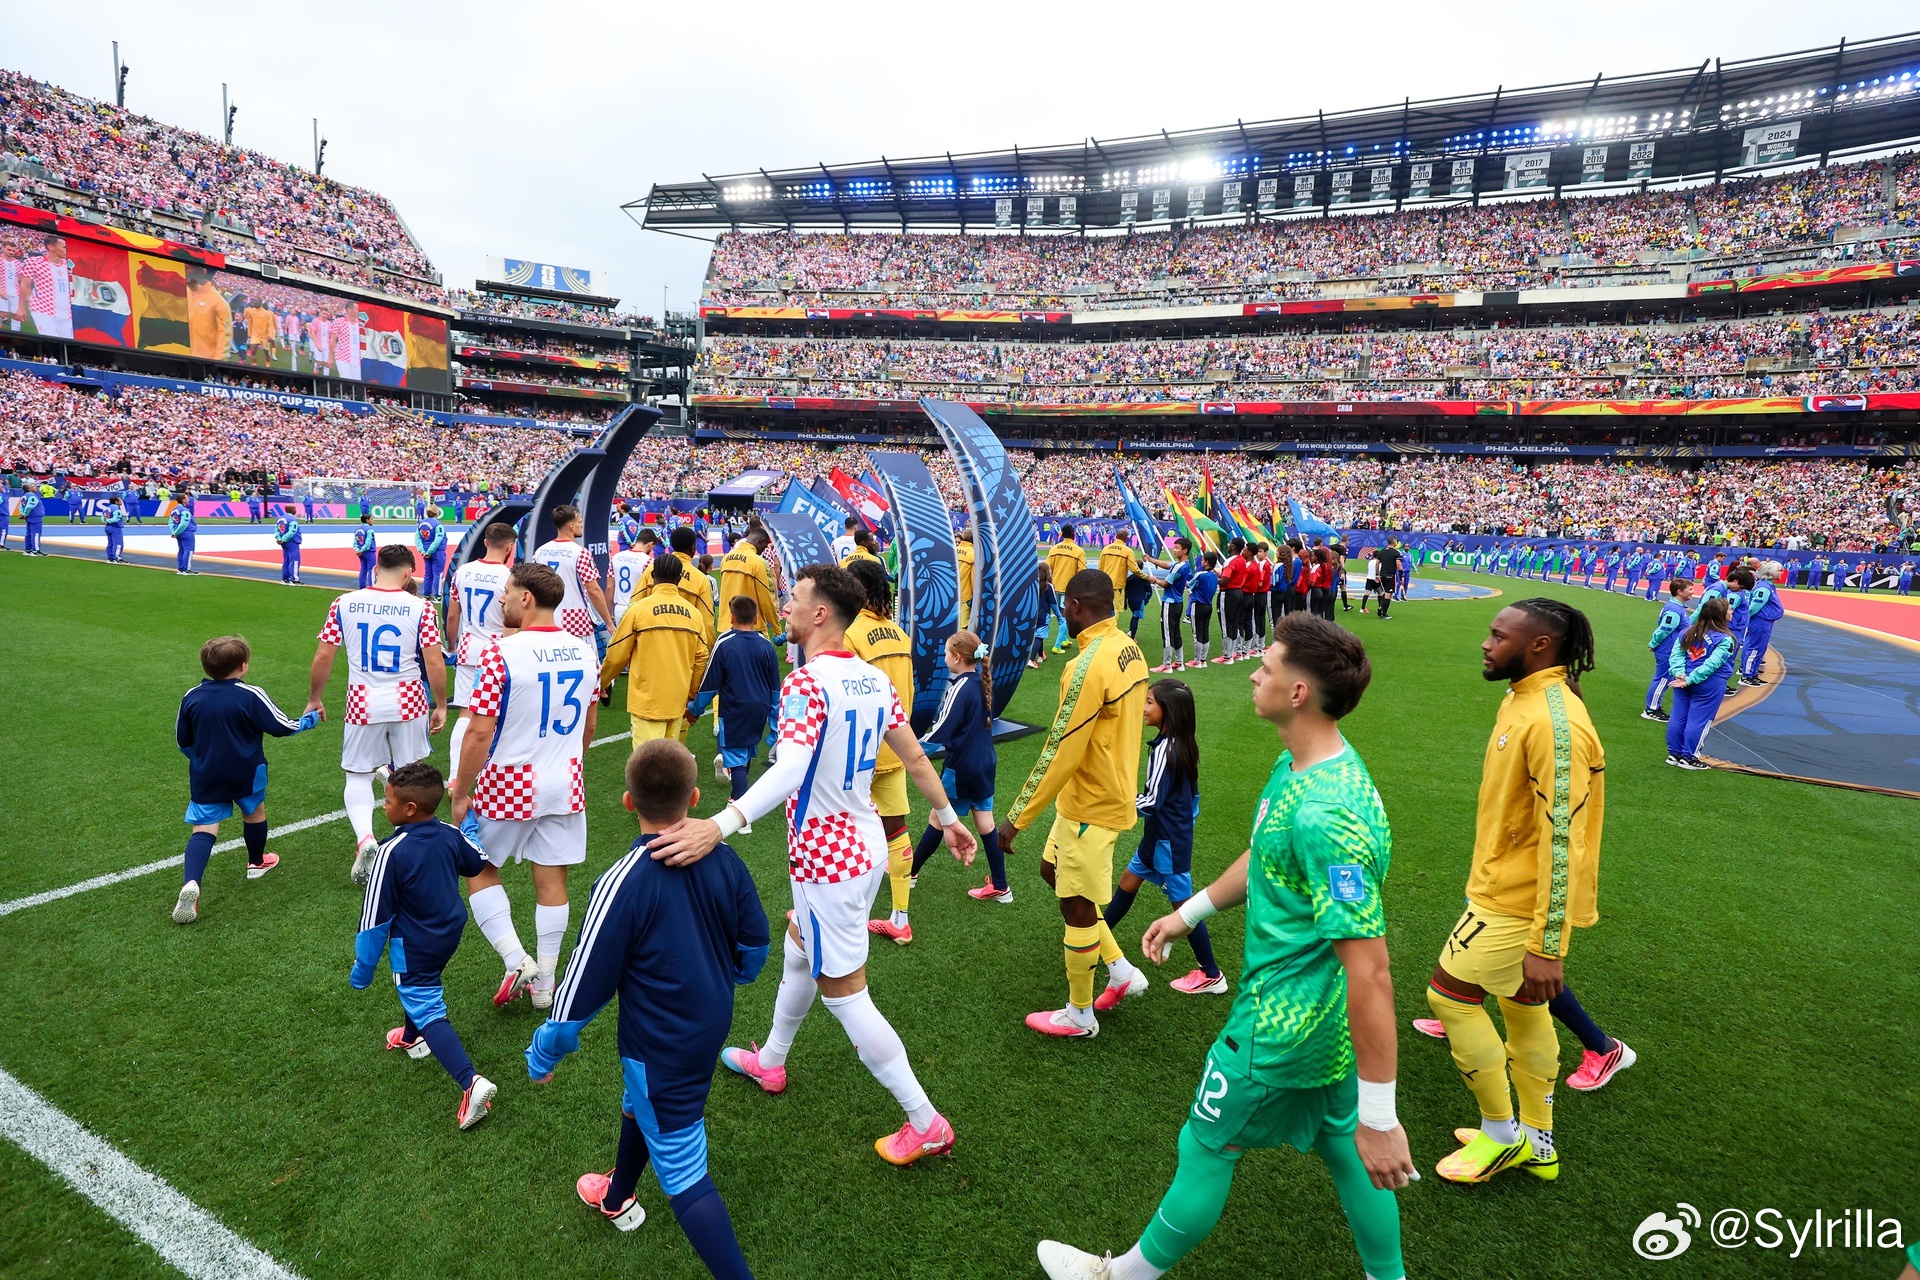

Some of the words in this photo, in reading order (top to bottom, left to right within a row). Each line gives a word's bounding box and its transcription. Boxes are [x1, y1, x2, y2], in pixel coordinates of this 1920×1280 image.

[1768, 130, 1791, 140] 2024
[1759, 146, 1795, 156] CHAMPIONS
[1767, 142, 1788, 150] WORLD
[1586, 155, 1604, 163] 2019
[1632, 151, 1652, 159] 2022
[1525, 159, 1543, 167] 2017
[201, 386, 229, 398] FIFA
[231, 389, 277, 403] WORLD
[279, 395, 303, 407] CUP
[304, 400, 343, 410] 2026
[535, 420, 607, 431] PHILADELPH
[792, 497, 838, 539] FIFA
[588, 542, 607, 555] FIFA
[1659, 550, 1684, 559] FIA
[725, 554, 747, 563] GHANA
[619, 566, 631, 593] 8
[349, 602, 410, 616] BATURINA
[465, 587, 494, 627] 17
[653, 604, 691, 619] GHANA
[867, 628, 901, 646] GHANA
[357, 622, 402, 672] 16
[1118, 646, 1142, 673] GHANA
[538, 670, 584, 738] 13
[843, 707, 884, 790] 14
[1453, 912, 1488, 950] 11
[1199, 1058, 1228, 1119] 12
